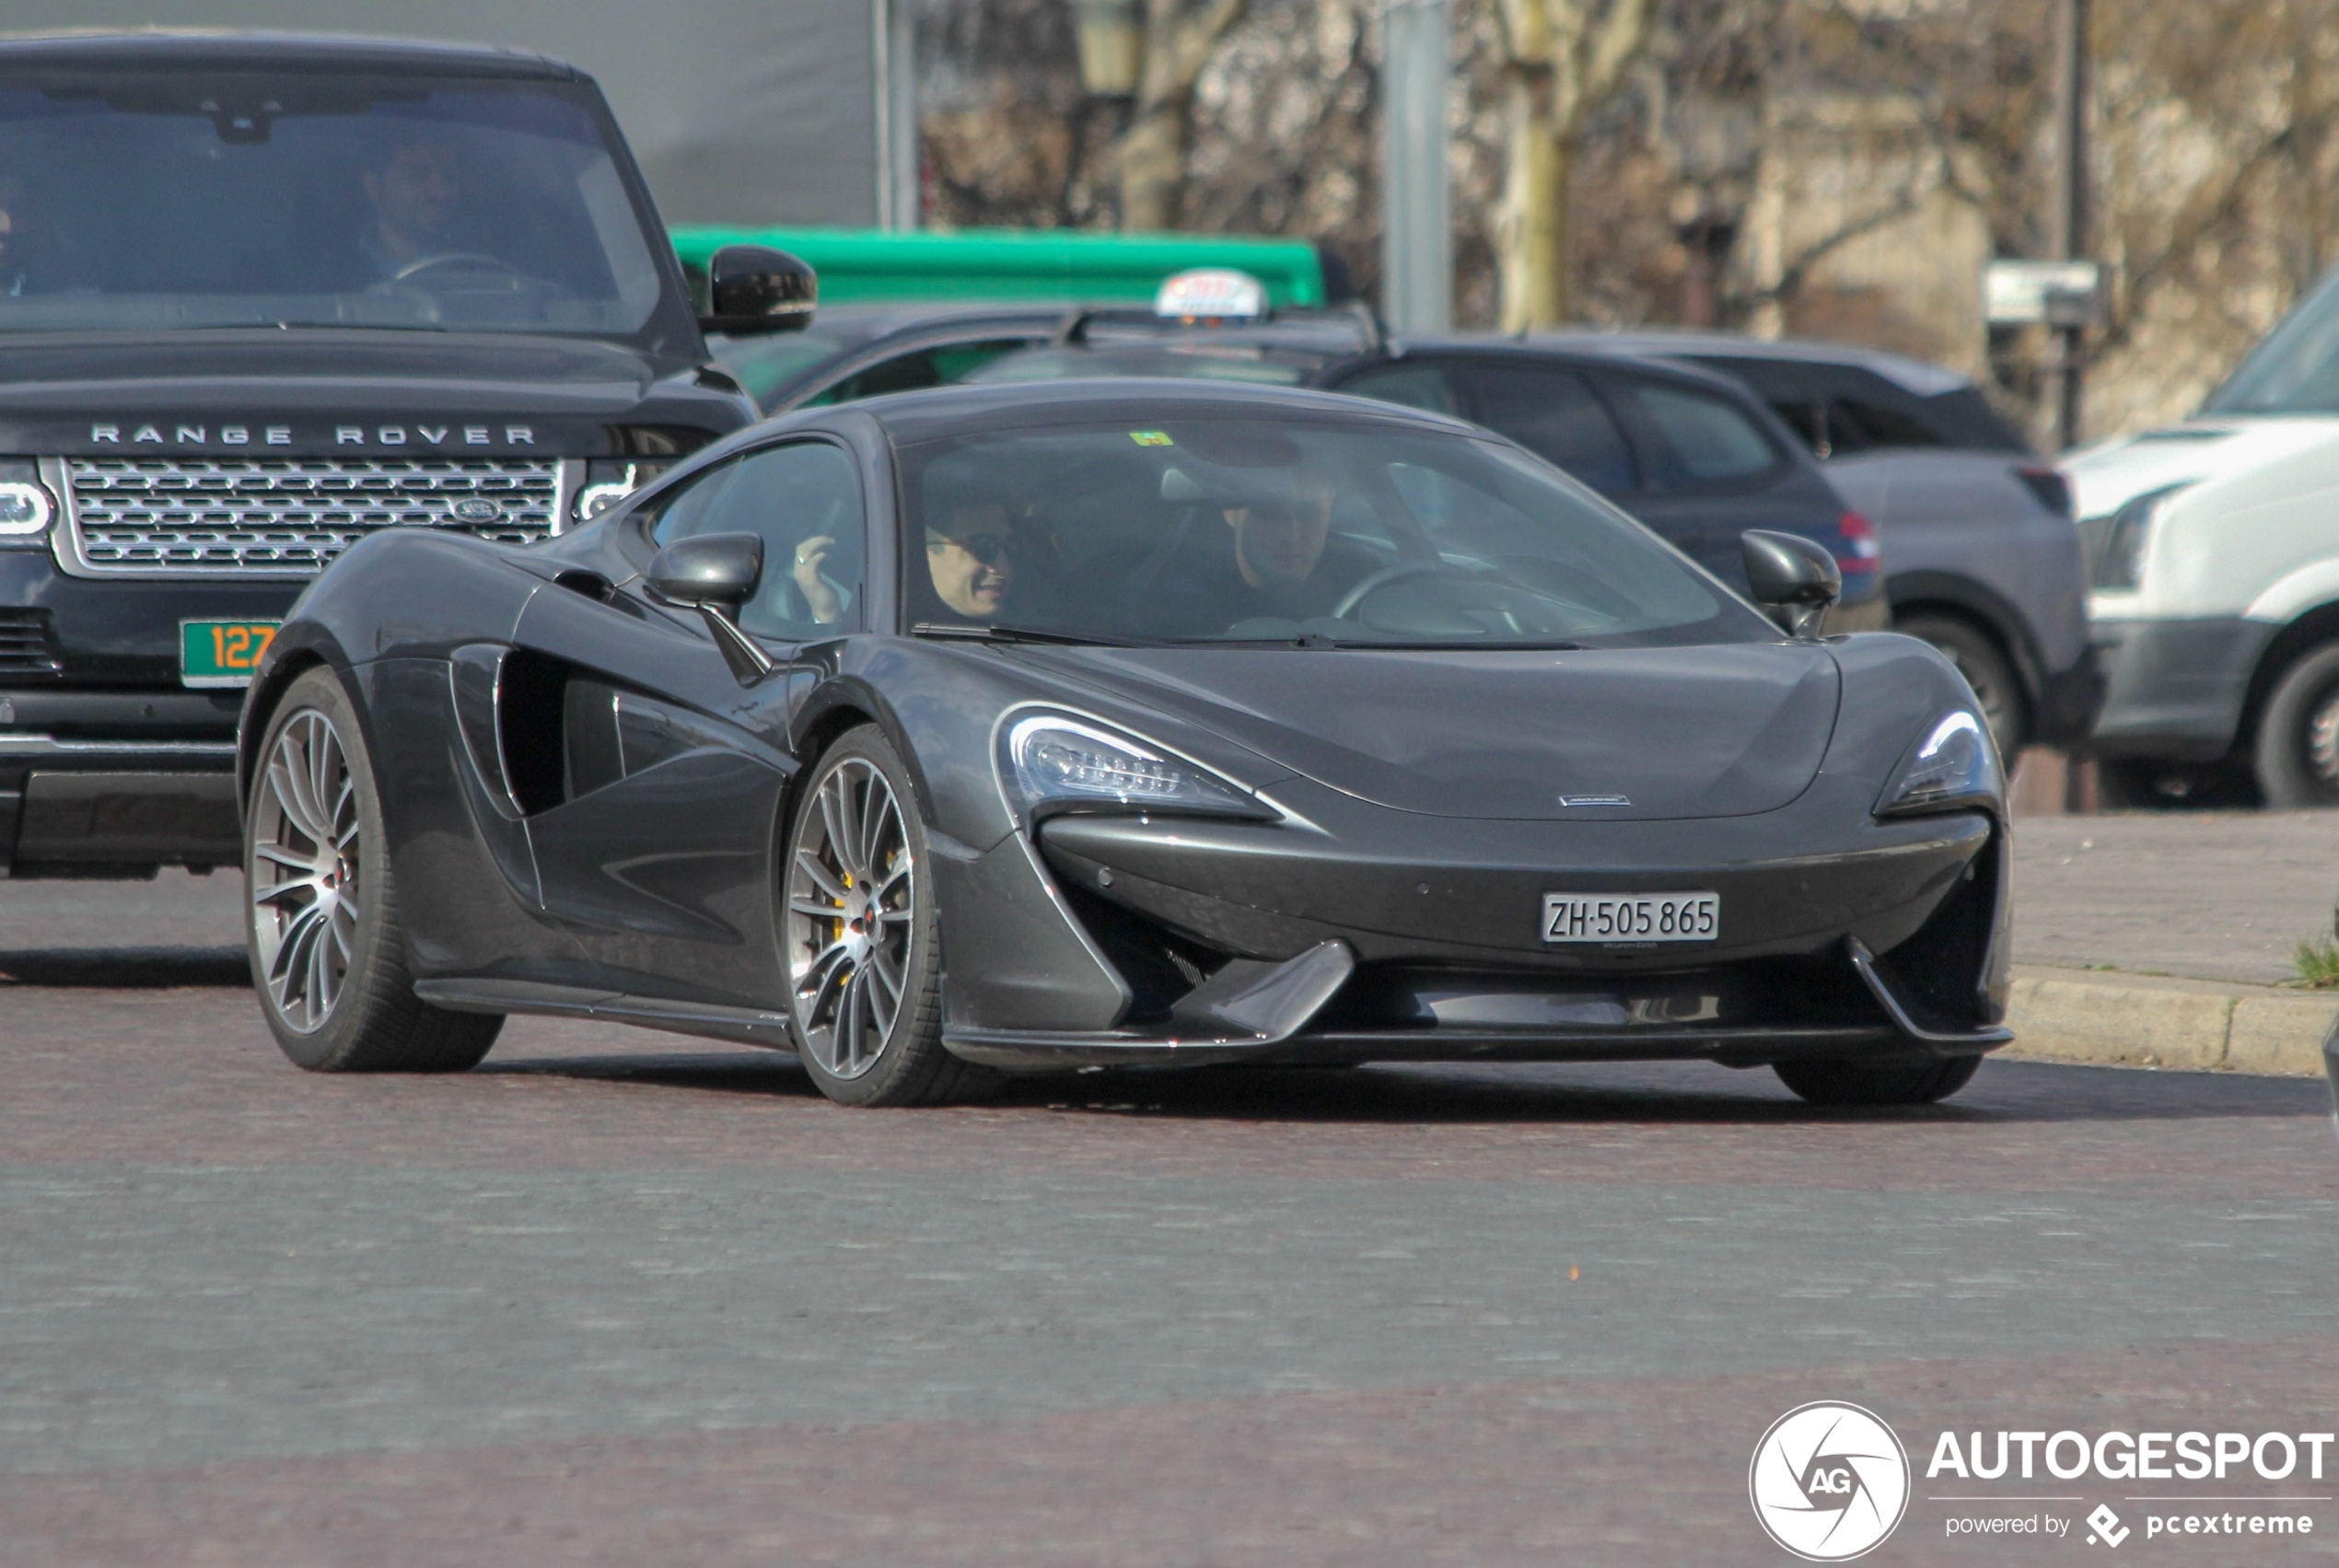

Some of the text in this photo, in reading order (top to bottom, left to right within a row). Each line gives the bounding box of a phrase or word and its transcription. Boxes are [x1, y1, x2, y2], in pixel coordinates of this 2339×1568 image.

[92, 424, 534, 445] RANGE ROVER
[1659, 900, 1715, 935] 865
